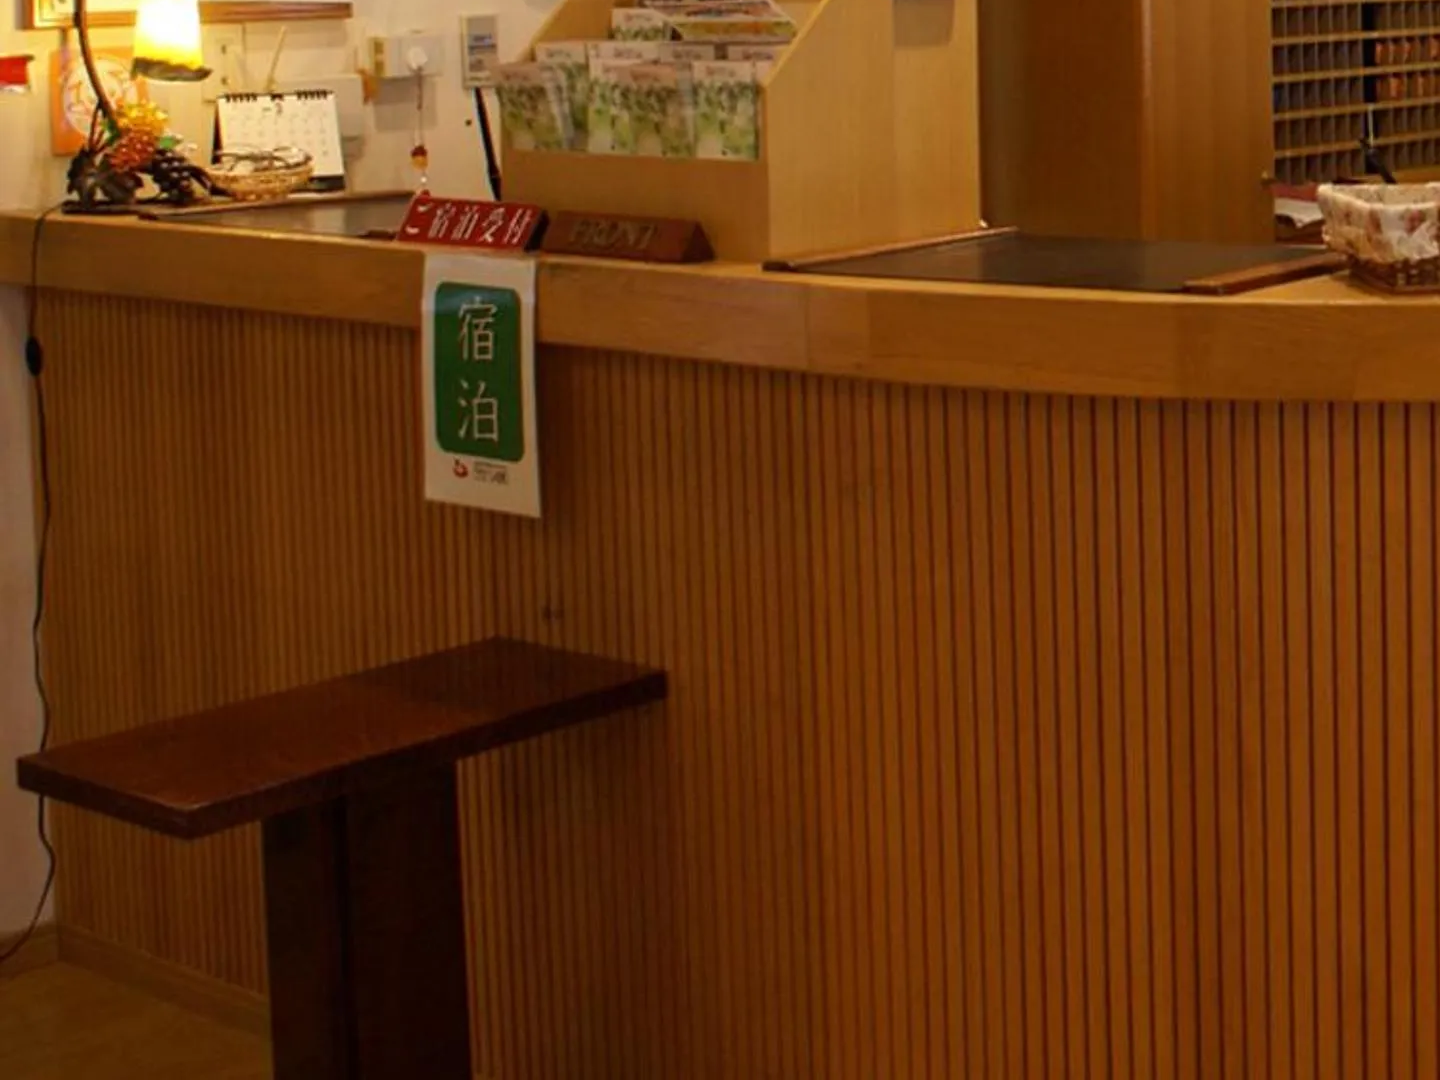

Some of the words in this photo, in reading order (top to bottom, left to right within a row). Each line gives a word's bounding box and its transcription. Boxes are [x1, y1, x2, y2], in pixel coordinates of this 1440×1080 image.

[404, 201, 532, 245] ご宿泊受付
[457, 296, 500, 442] 宿泊
